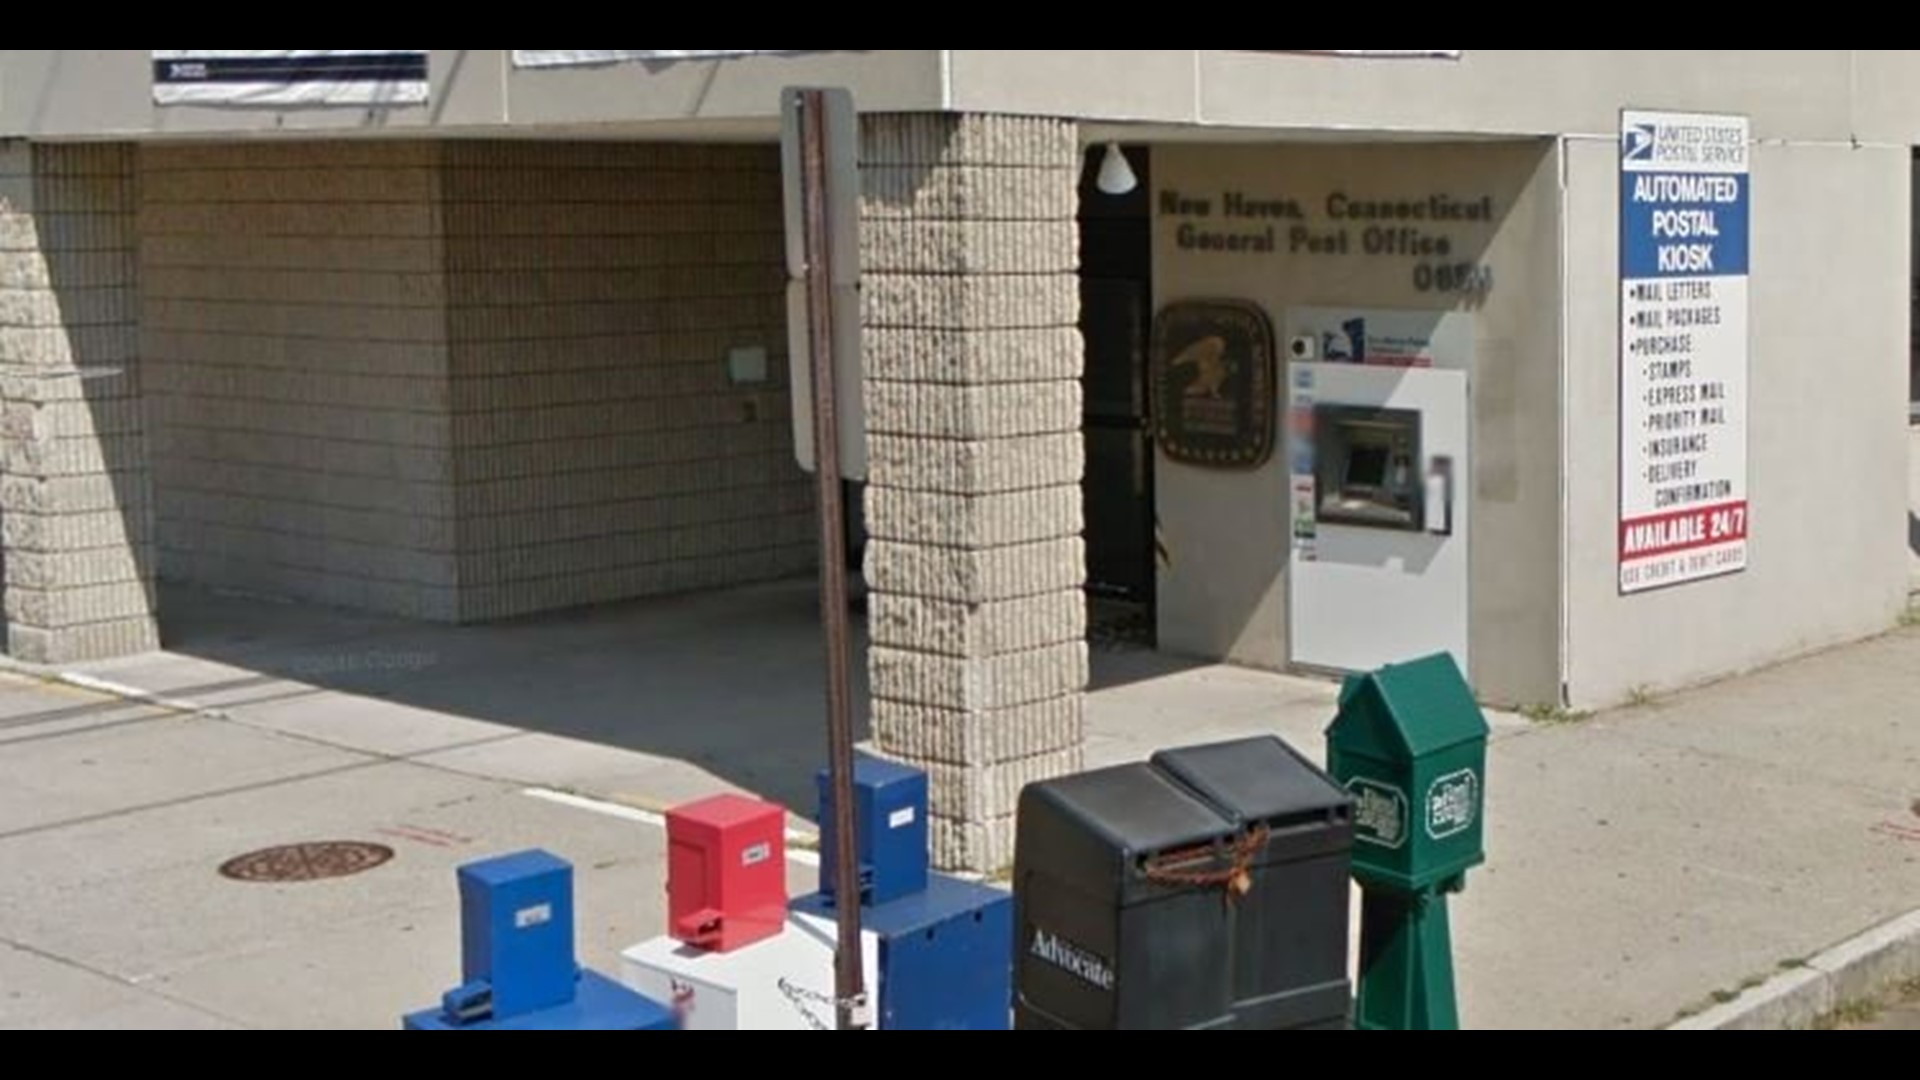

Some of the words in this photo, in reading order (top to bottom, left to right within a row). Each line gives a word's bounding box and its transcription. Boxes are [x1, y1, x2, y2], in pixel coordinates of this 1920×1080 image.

[1658, 125, 1701, 144] UNITED
[1704, 126, 1742, 145] STATES
[1656, 145, 1698, 162] POSTAL
[1702, 146, 1745, 163] SERVICE
[1633, 175, 1738, 203] AUTOMATED
[1159, 190, 1210, 217] New
[1325, 191, 1493, 221] Connecticut
[1652, 210, 1719, 237] POSTAL
[1176, 223, 1275, 253] General
[1290, 226, 1347, 255] Post
[1362, 227, 1451, 256] Office
[1657, 244, 1713, 271] KIOSK
[1637, 283, 1662, 301] MAIL
[1666, 281, 1711, 301] LETTERS
[1637, 311, 1662, 329] MAIL
[1667, 306, 1721, 327] PACKAGES
[1649, 359, 1692, 381] STAMPS
[1648, 384, 1696, 406] EXPRESS
[1700, 382, 1725, 400] MAIL
[1649, 409, 1696, 432] PRIORITY
[1701, 407, 1725, 424] MAIL
[1649, 433, 1707, 458] INSURANCE
[1649, 460, 1697, 484] DELIVERY
[1655, 479, 1732, 508] CONFIRMATION
[1623, 513, 1706, 554] AVAILABLE
[1710, 507, 1745, 538] 24/7
[1031, 929, 1115, 991] Advocate
